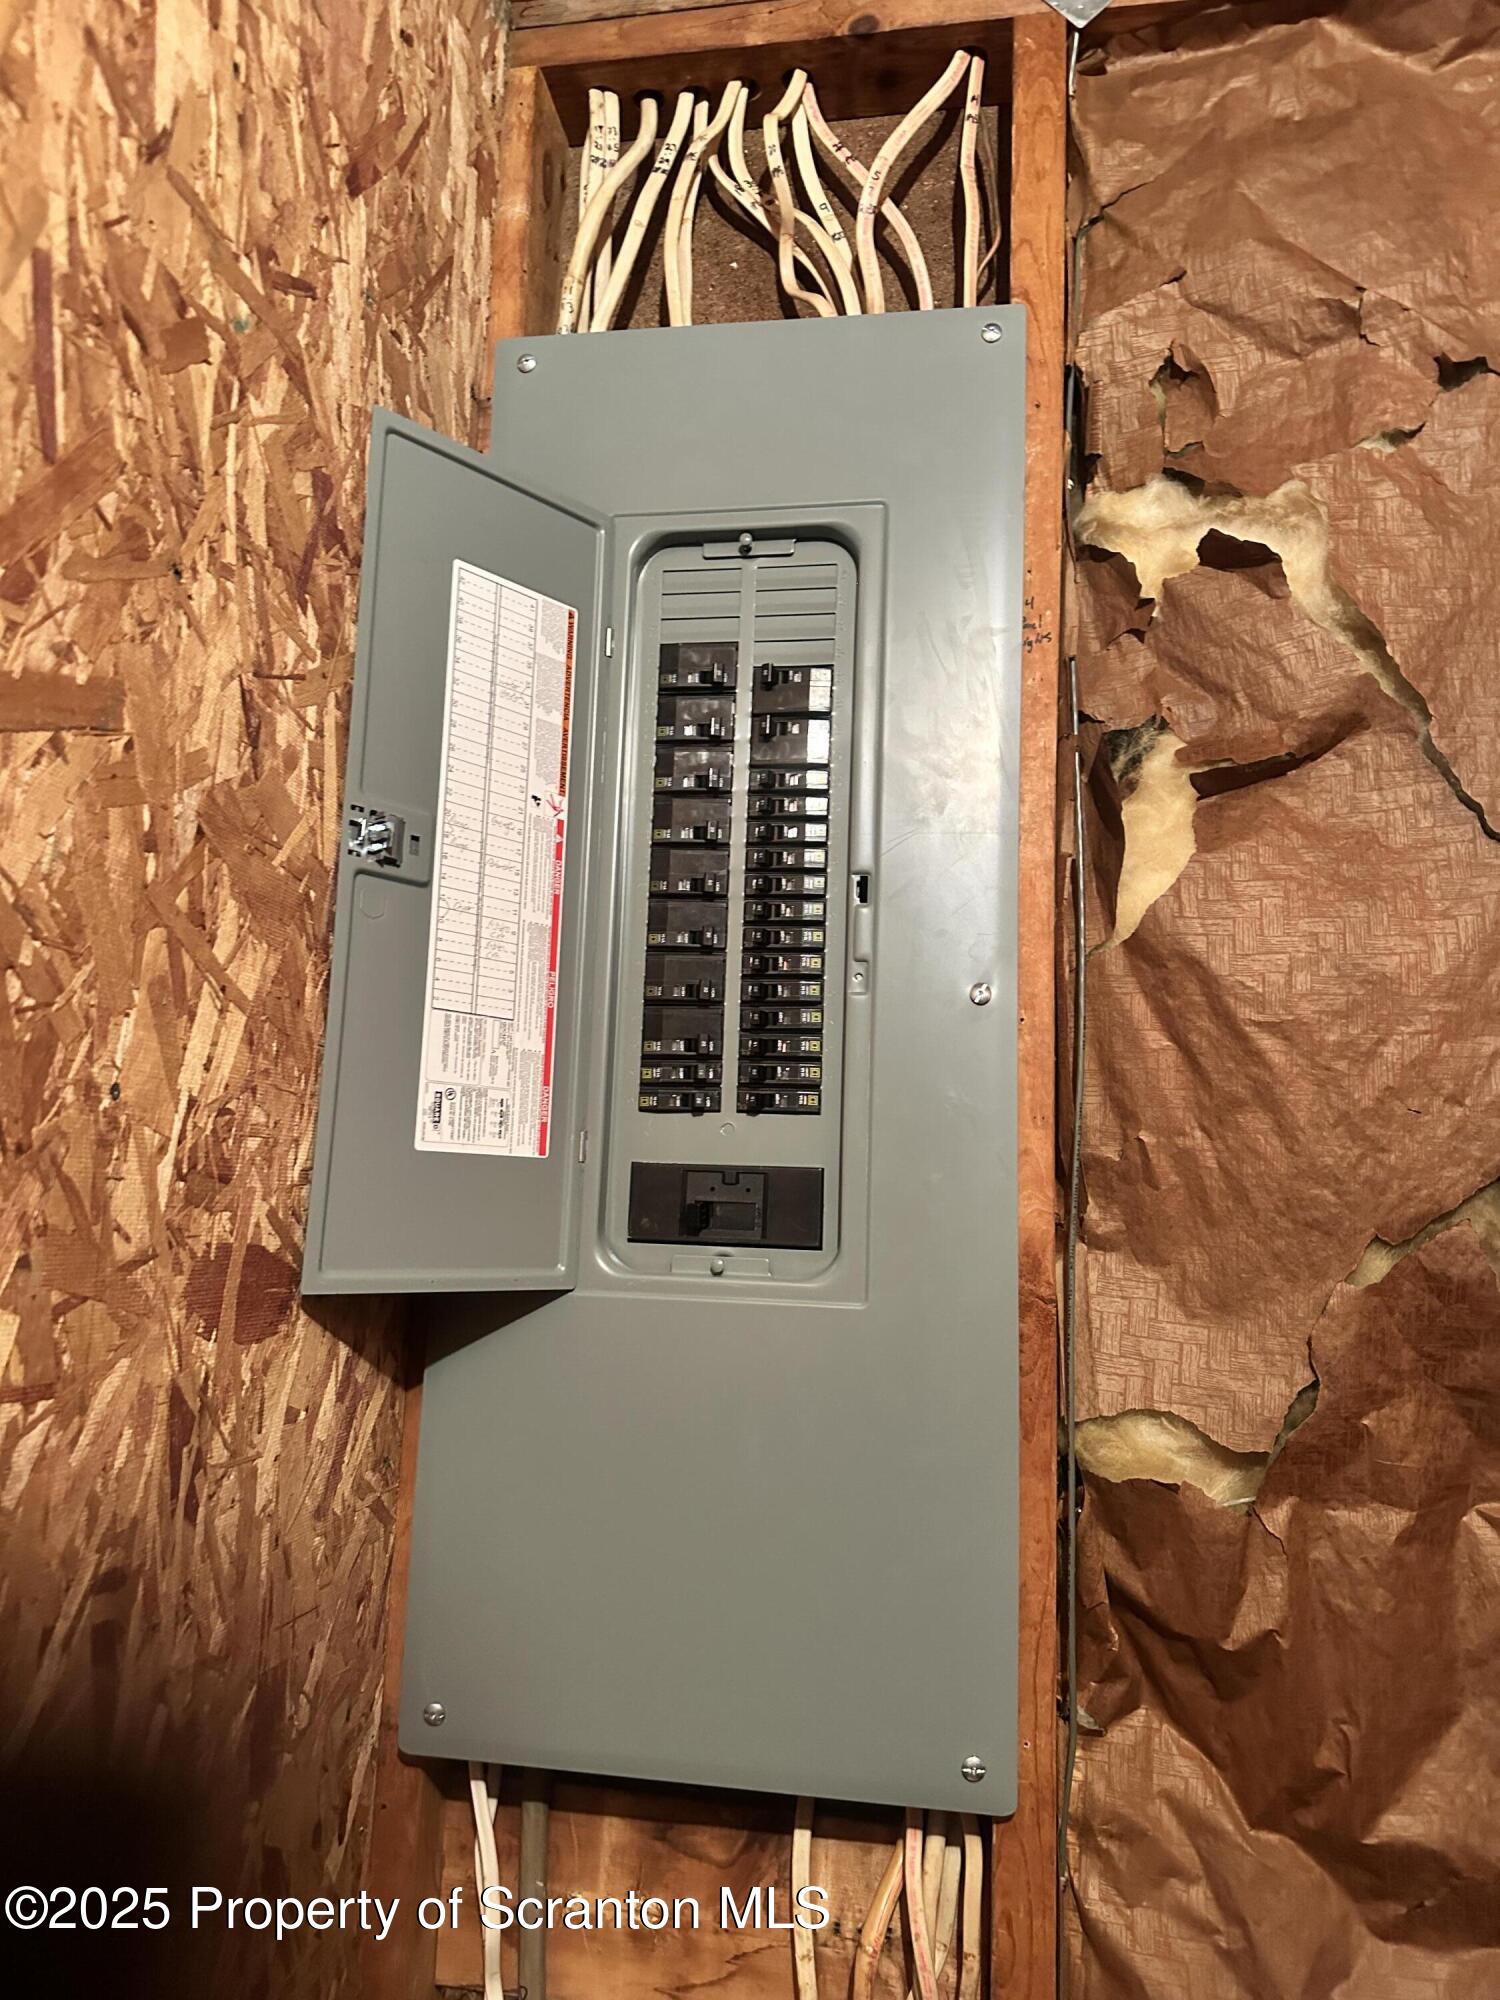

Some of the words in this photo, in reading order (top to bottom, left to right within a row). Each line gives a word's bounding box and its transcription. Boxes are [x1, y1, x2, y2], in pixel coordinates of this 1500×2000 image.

[566, 621, 574, 660] WARNING
[553, 860, 561, 896] DANGER
[541, 1087, 549, 1123] DANGER
